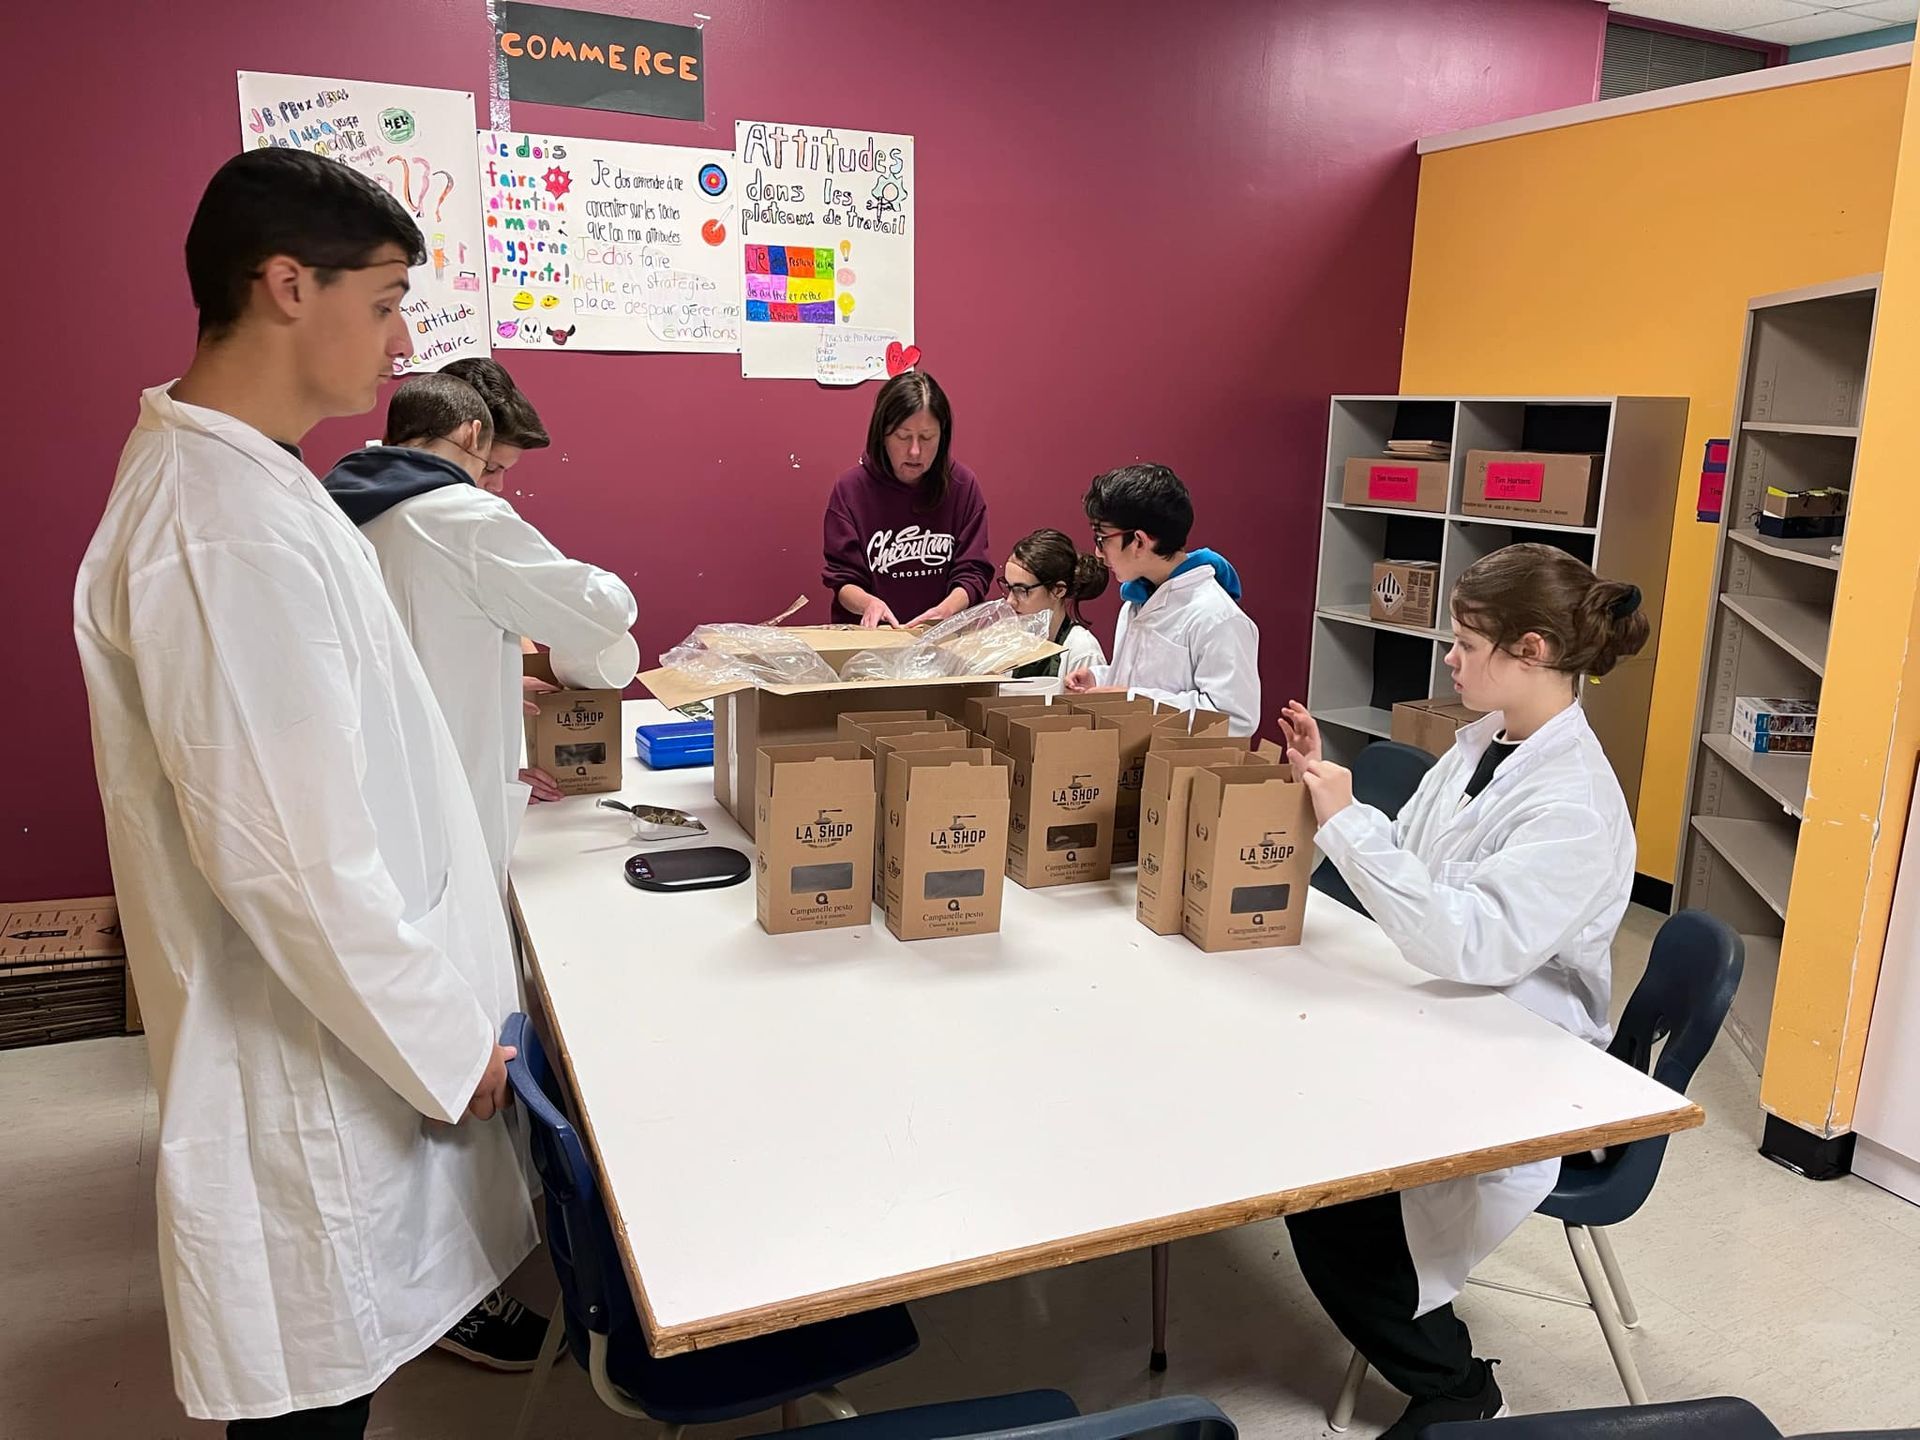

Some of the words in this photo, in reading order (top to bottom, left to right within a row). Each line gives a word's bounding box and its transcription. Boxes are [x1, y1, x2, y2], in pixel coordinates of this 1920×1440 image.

[500, 32, 698, 81] COMMERCE
[486, 133, 509, 157] Je
[515, 135, 567, 159] dois
[743, 123, 904, 174] Attitudes
[486, 161, 536, 188] faire
[591, 159, 611, 188] Je
[746, 167, 806, 203] dans
[823, 178, 853, 207] les
[490, 190, 565, 212] attention
[644, 200, 656, 220] les
[504, 217, 550, 231] mon
[742, 201, 815, 235] plateaux
[822, 208, 842, 225] de
[847, 205, 906, 235] travail
[587, 221, 608, 242] que
[573, 236, 602, 264] Je
[602, 246, 633, 266] dois
[640, 245, 671, 269] faire
[573, 272, 617, 294] mettre
[622, 281, 643, 295] en
[573, 293, 617, 315] place
[417, 303, 475, 334] attitude
[891, 567, 945, 579] CROSSFIT
[556, 713, 571, 724] LA
[576, 711, 605, 723] SHOP
[1052, 790, 1067, 803] LA
[1072, 788, 1100, 801] SHOP
[796, 826, 813, 840] LA
[819, 823, 853, 838] SHOP
[930, 831, 947, 845] LA
[953, 830, 986, 844] SHOP
[1240, 848, 1256, 861] LA
[1262, 846, 1294, 860] SHOP
[790, 905, 833, 916] Campanelle
[833, 903, 854, 913] pesto
[922, 911, 964, 922] Campanelle
[964, 910, 984, 919] pesto
